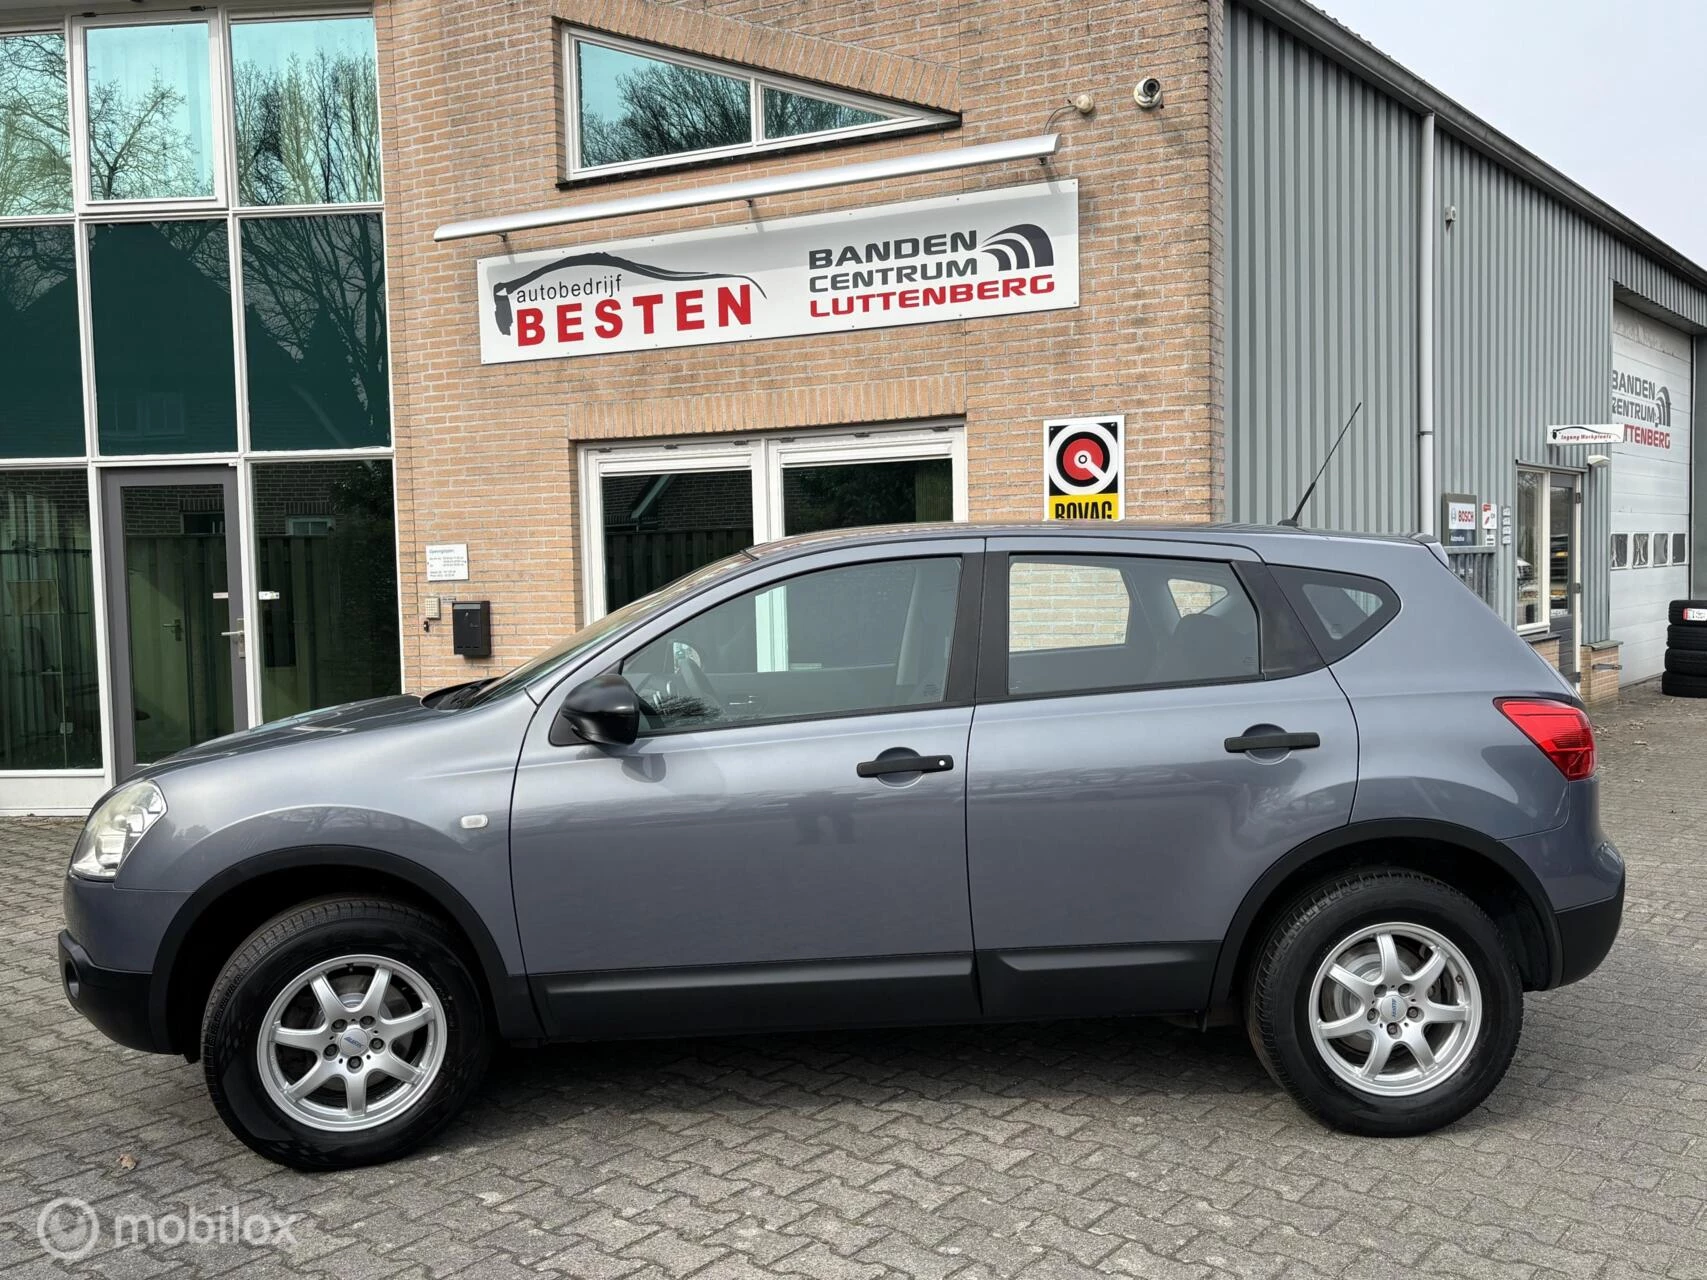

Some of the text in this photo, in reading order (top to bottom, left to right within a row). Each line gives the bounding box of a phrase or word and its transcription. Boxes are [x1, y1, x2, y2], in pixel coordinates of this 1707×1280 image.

[808, 230, 977, 270] BANDEN
[516, 274, 623, 303] autobedrijf
[809, 257, 978, 293] CENTRUM
[810, 274, 1055, 318] LUTTENBERG
[516, 284, 752, 347] BESTEN
[1458, 510, 1474, 523] BOSCH
